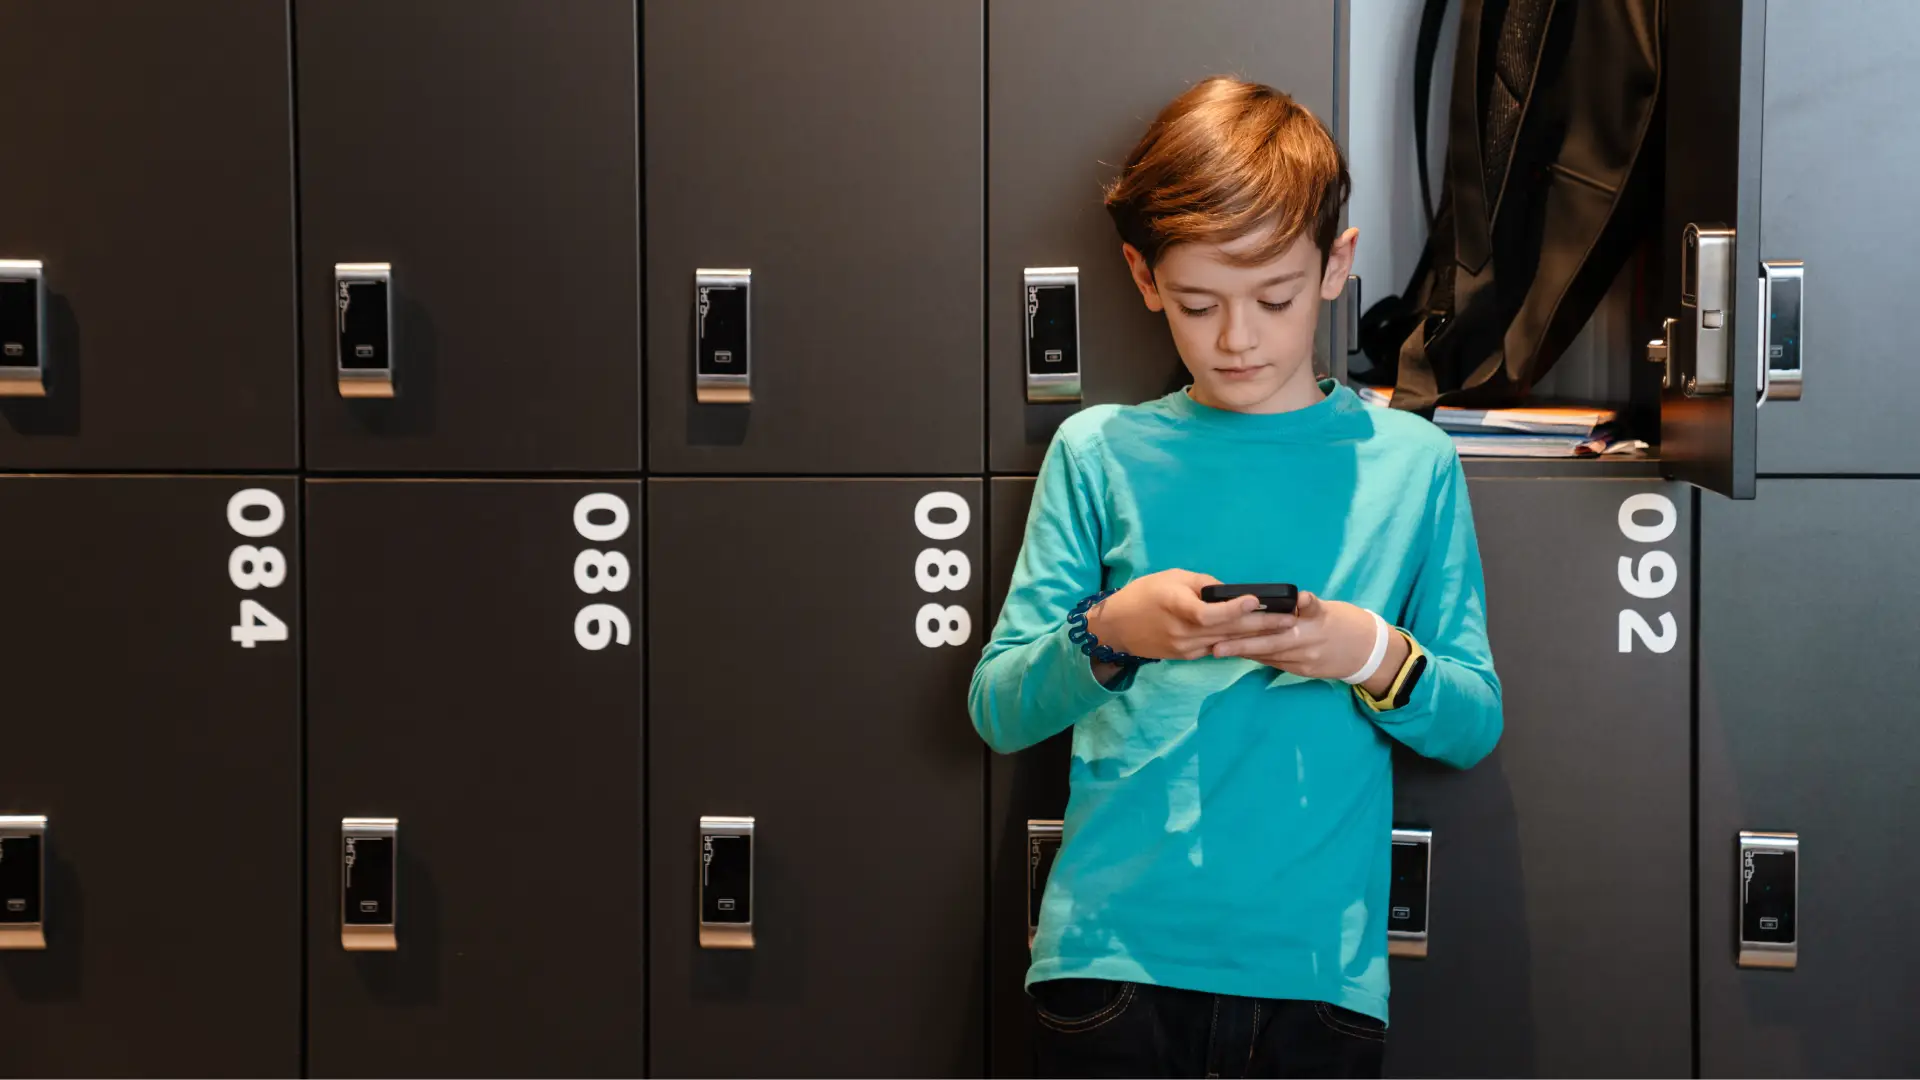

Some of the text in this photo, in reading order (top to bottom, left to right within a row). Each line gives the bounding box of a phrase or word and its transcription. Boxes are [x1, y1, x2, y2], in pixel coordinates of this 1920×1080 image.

[227, 488, 288, 648] 084
[573, 493, 631, 651] 086
[914, 491, 972, 648] 088
[1618, 493, 1678, 653] 092
